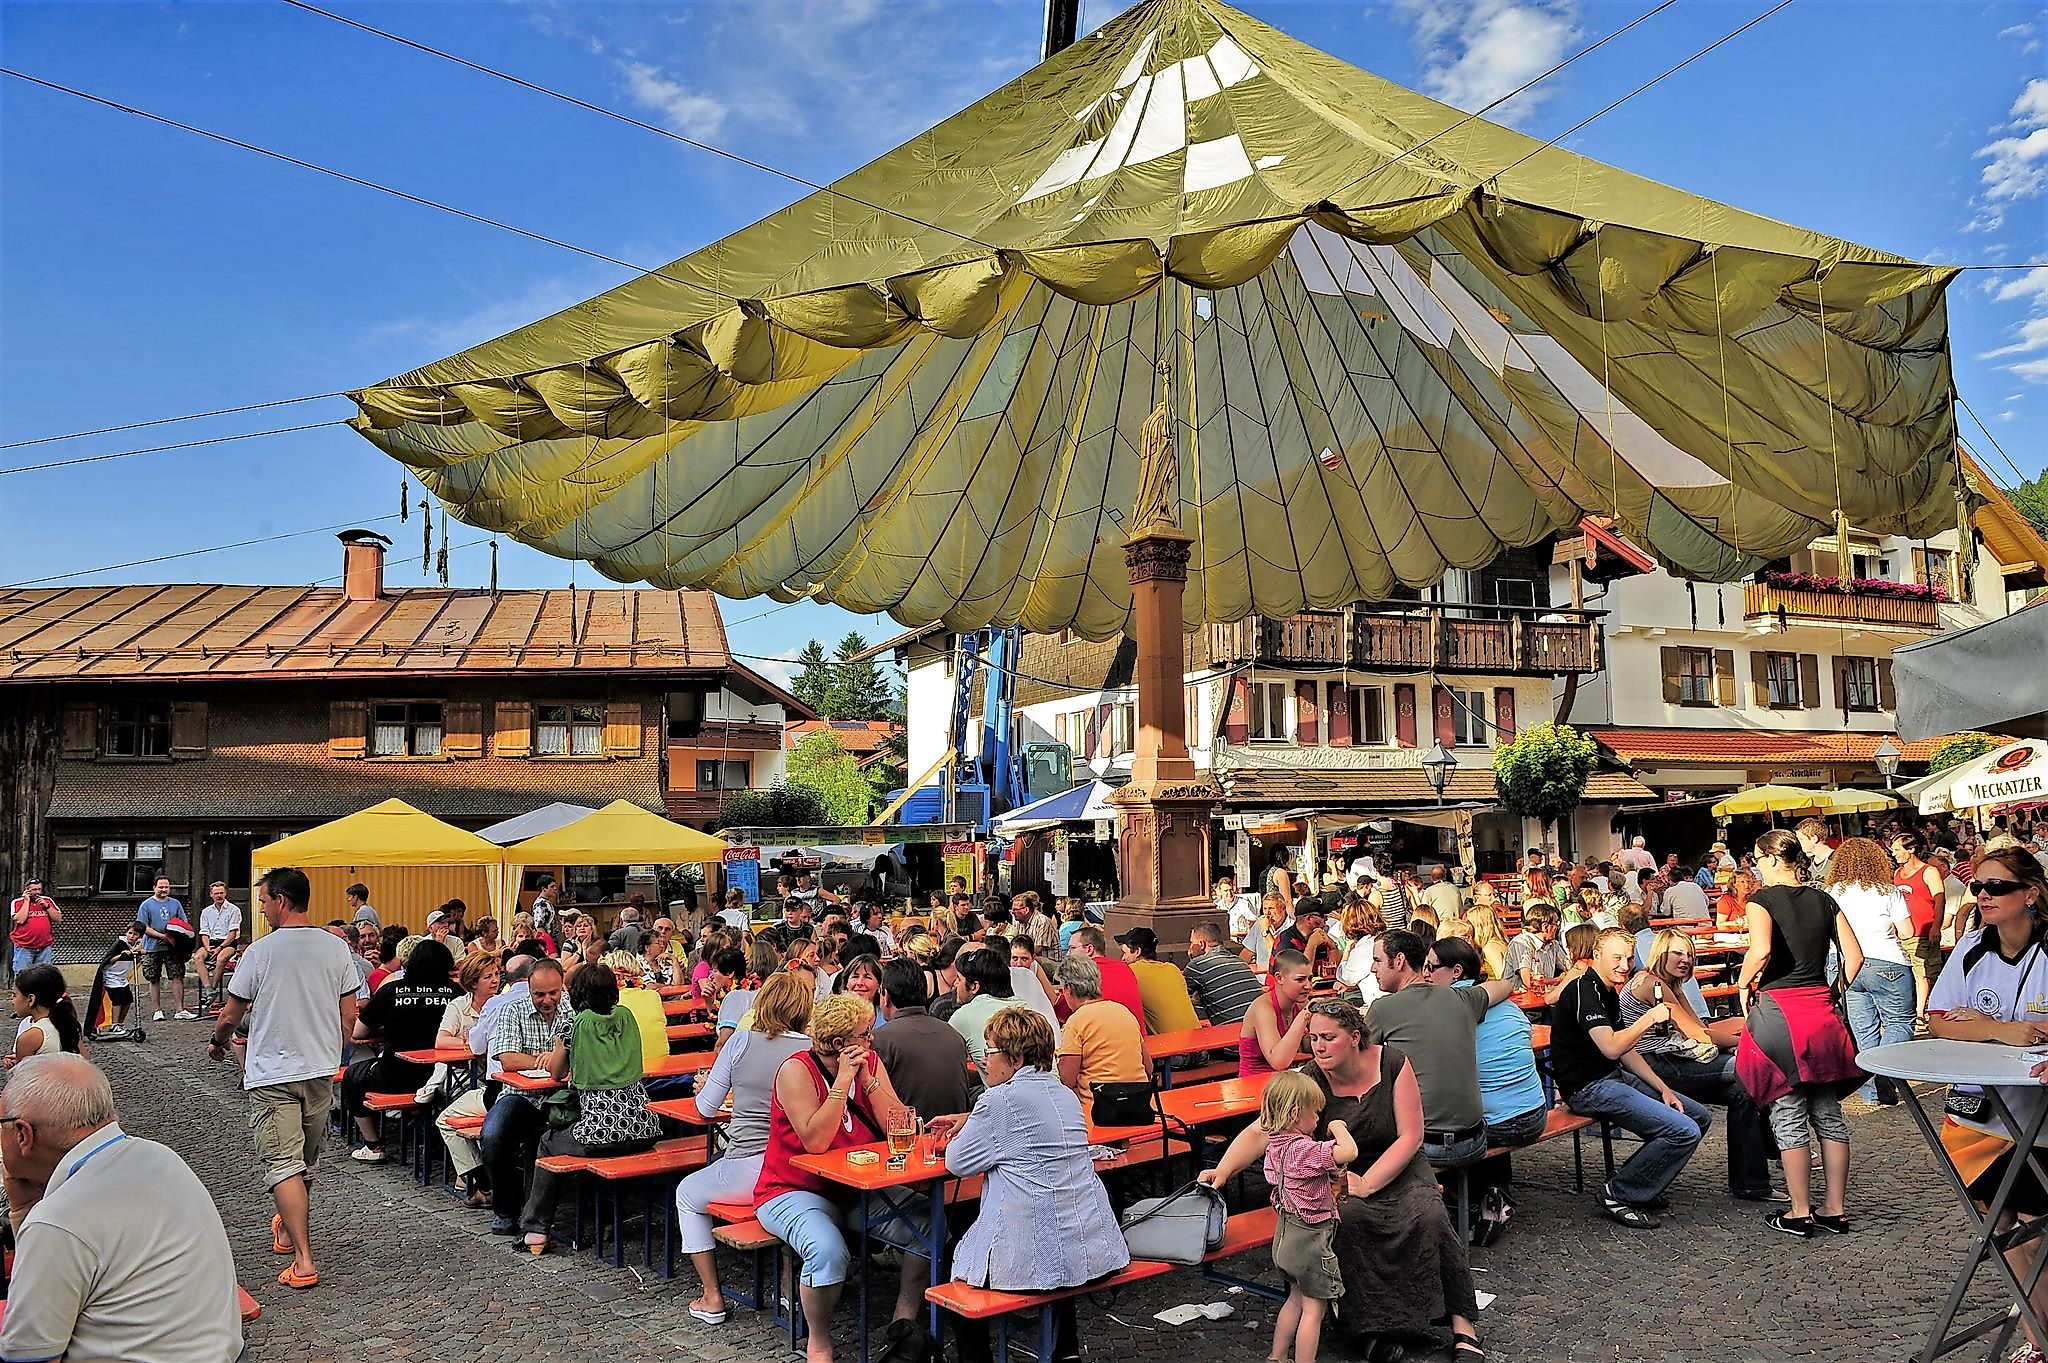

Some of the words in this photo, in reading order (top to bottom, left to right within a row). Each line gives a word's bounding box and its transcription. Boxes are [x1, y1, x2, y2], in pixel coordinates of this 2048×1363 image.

[1968, 777, 2042, 800] MECKATZER
[395, 986, 411, 994] Ich
[438, 986, 453, 994] ein
[395, 997, 419, 1006] HOT
